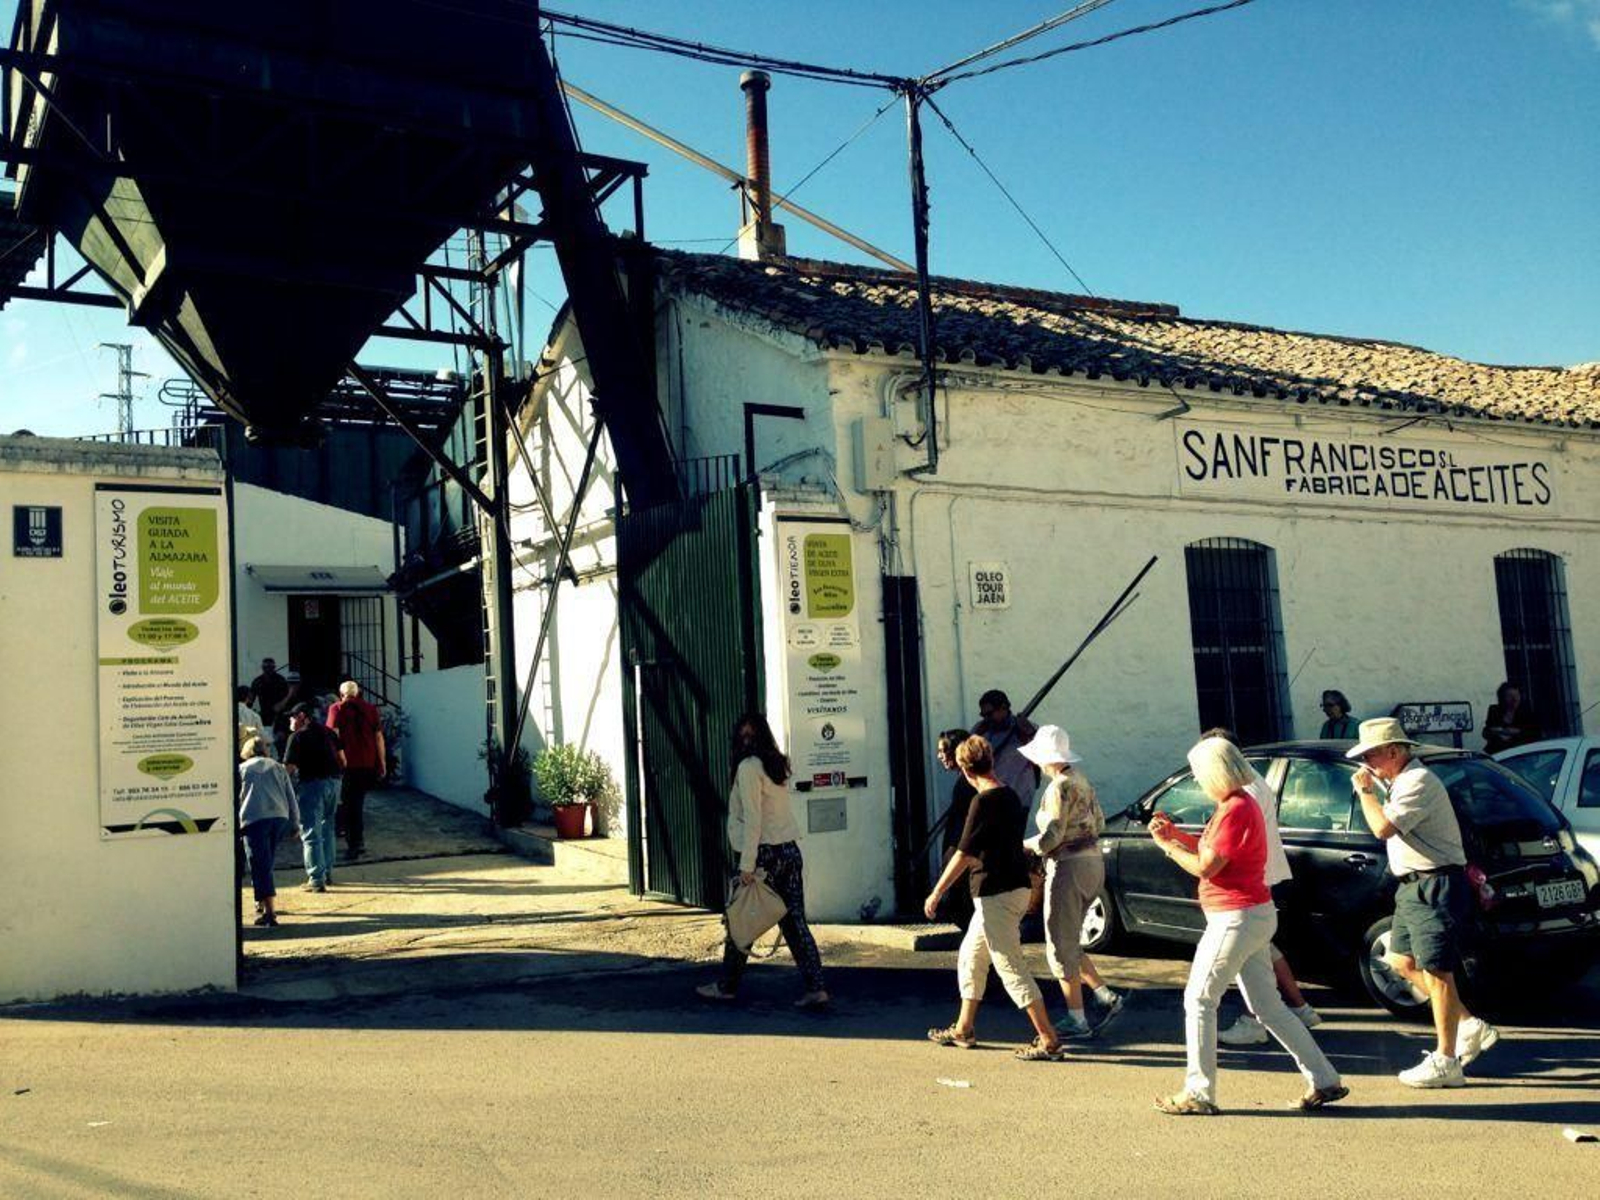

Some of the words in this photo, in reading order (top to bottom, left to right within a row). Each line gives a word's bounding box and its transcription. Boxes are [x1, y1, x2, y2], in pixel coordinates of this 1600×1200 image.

[148, 515, 180, 526] VISITA
[148, 528, 190, 538] GUIADA
[149, 540, 157, 549] A
[160, 541, 174, 549] LA
[149, 552, 208, 563] ALMAZARA
[975, 571, 1004, 582] OLEO
[976, 582, 1004, 593] TOUR
